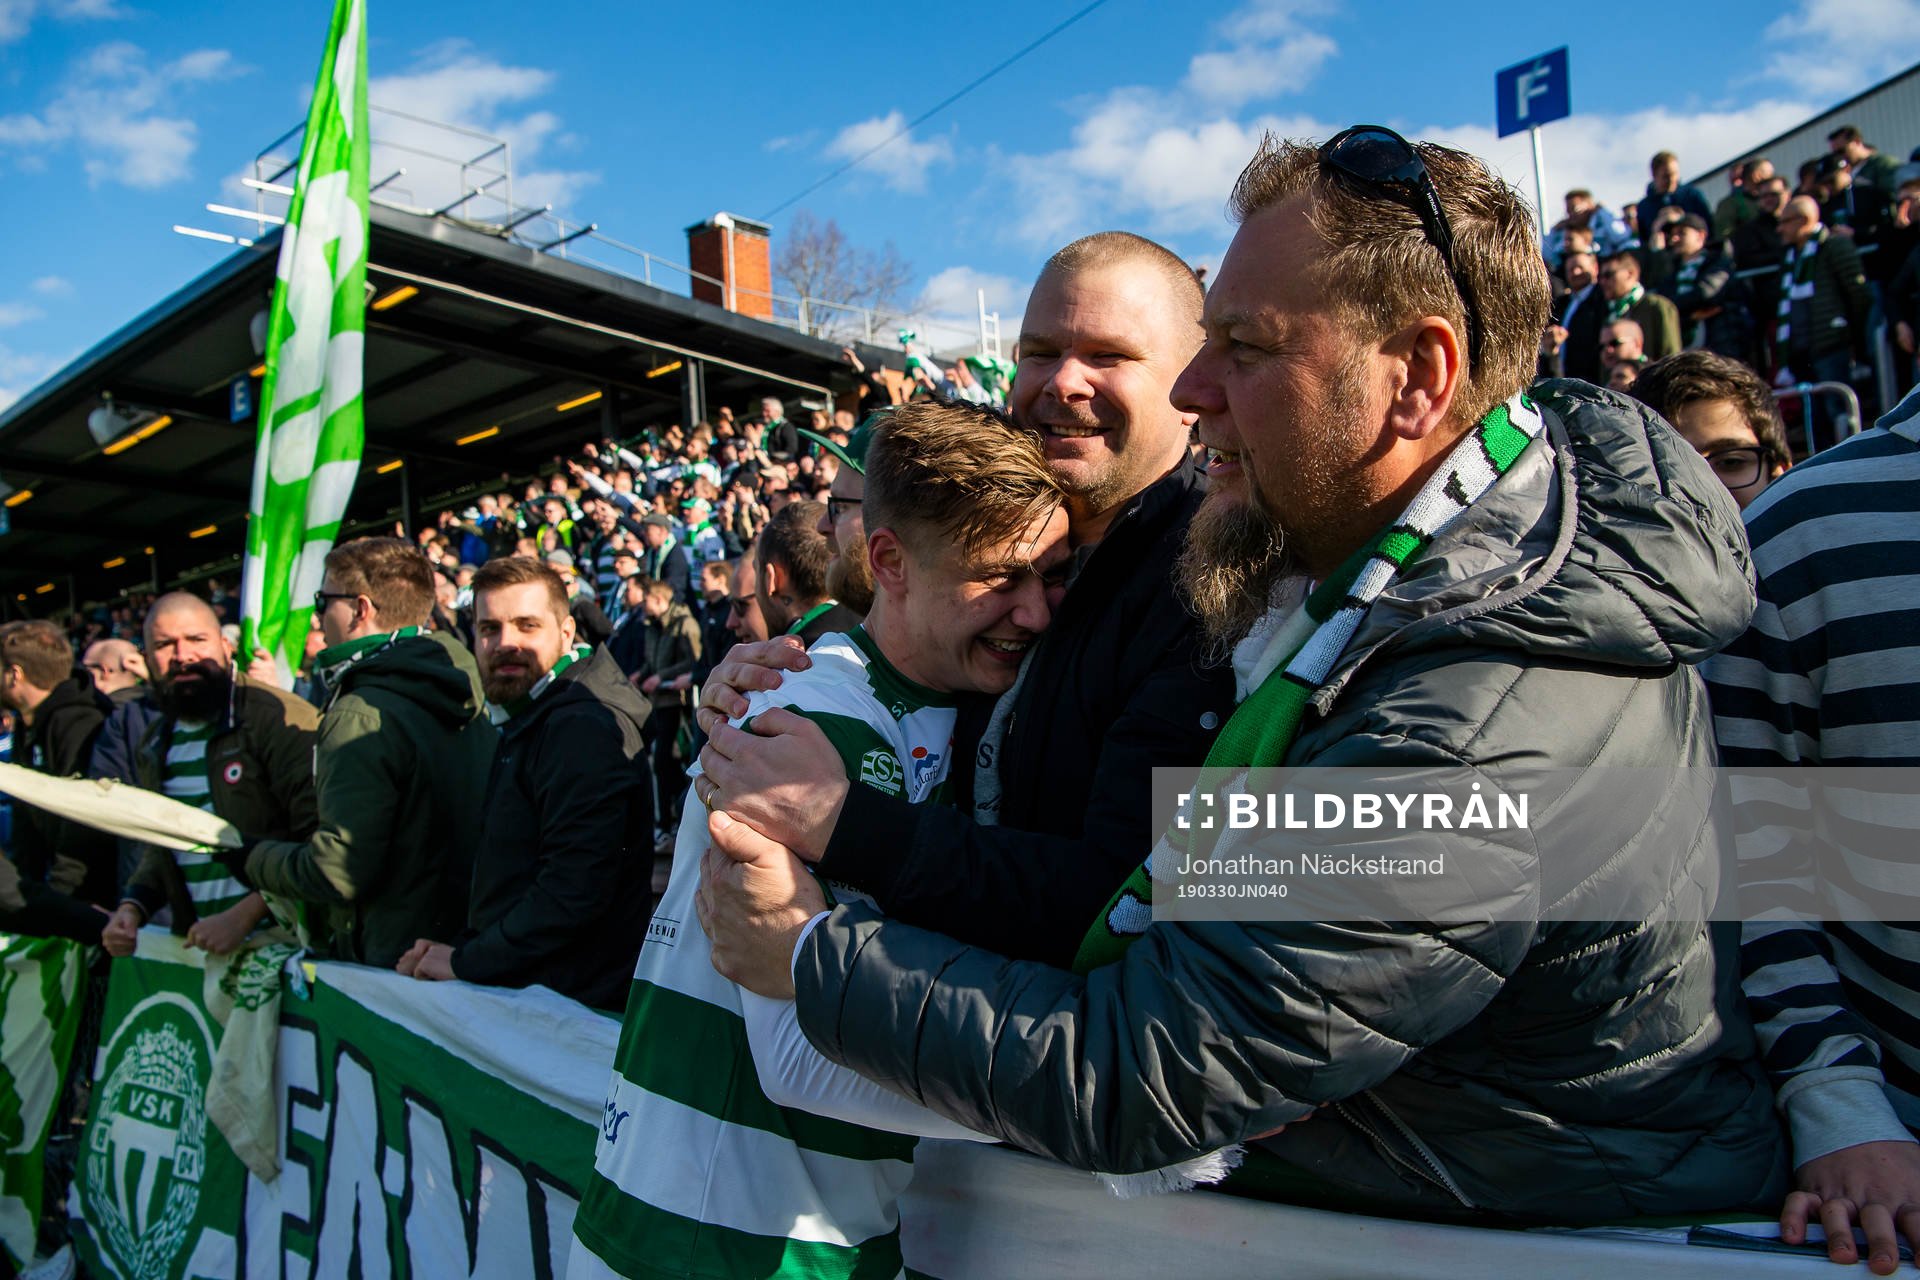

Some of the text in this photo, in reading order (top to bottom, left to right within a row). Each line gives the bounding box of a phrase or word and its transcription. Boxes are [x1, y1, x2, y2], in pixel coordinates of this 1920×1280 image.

[1518, 64, 1551, 119] F
[234, 380, 246, 412] E
[129, 1088, 175, 1123] VSK
